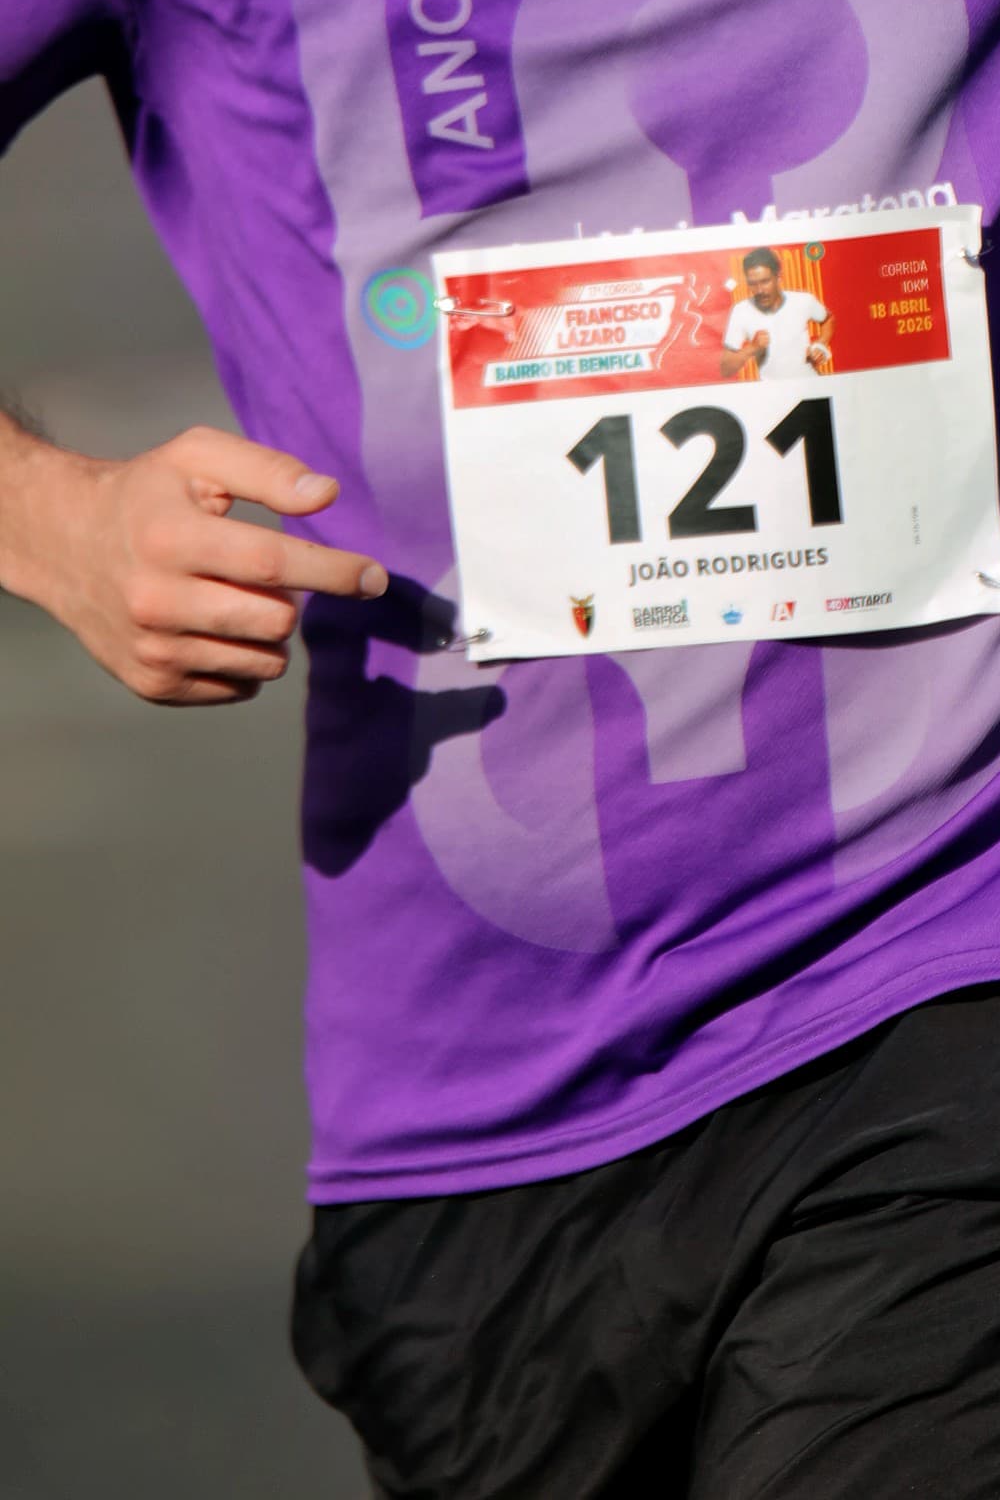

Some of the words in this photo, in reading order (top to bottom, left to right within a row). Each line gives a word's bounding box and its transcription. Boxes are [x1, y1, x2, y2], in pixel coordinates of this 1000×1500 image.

[881, 260, 928, 277] CORRIDA
[903, 278, 929, 293] 10KM
[565, 301, 661, 327] FRANCISCO
[870, 302, 887, 319] 18
[890, 297, 931, 316] ABRIL
[897, 315, 933, 335] 2026
[557, 326, 626, 349] LÁZARO
[495, 361, 552, 382] BAIRRO
[555, 358, 577, 375] DE
[579, 352, 644, 373] BENFICA
[566, 396, 844, 546] 121
[629, 556, 690, 587] JOÃO
[697, 548, 829, 576] RODRIGUES
[634, 612, 690, 628] BENFICA
